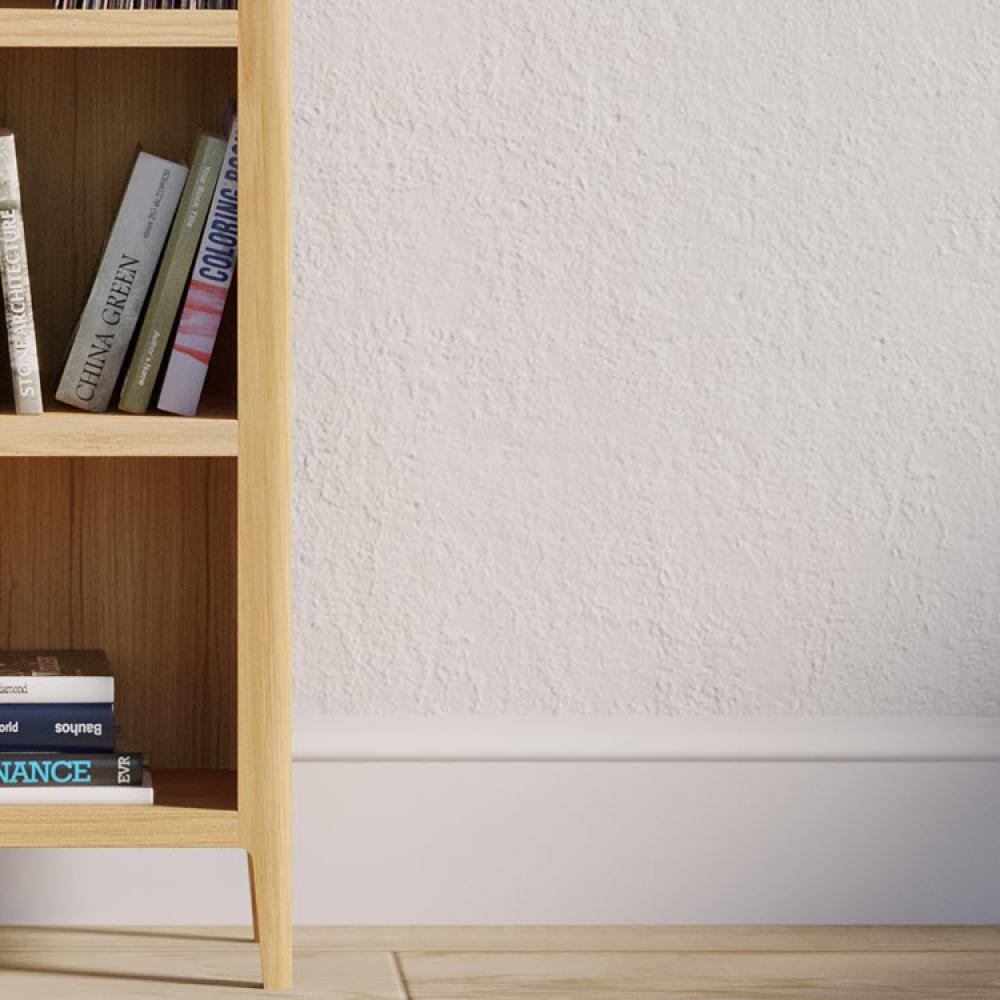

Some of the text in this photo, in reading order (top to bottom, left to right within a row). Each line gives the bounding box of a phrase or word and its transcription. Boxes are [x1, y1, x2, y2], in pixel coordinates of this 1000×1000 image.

[2, 208, 27, 336] ARCHITECTURE
[199, 187, 238, 282] COLORING
[75, 254, 141, 401] CHINA GREEN
[55, 723, 102, 736] Bauhos
[118, 755, 131, 784] EVR
